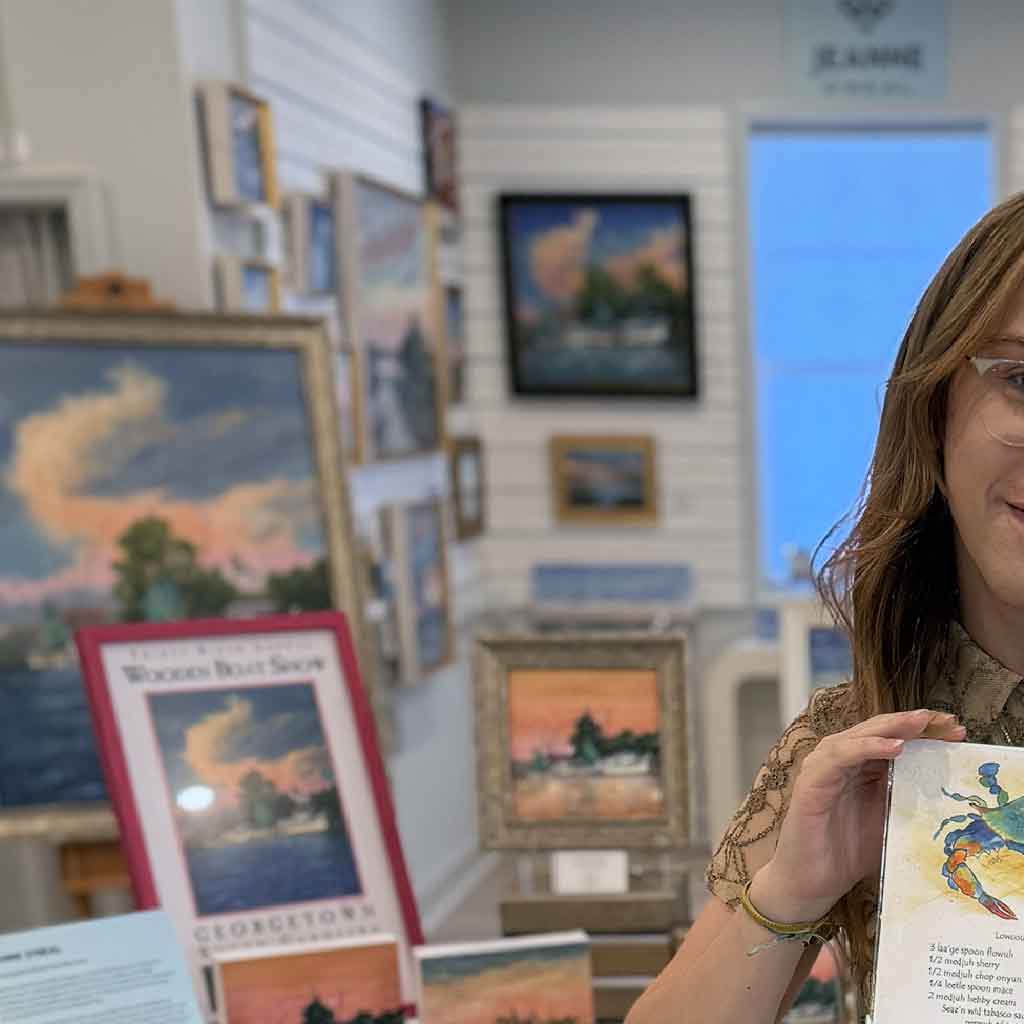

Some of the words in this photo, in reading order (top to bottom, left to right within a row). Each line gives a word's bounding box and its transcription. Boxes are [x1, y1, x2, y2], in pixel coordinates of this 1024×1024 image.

[960, 946, 984, 957] spoon
[928, 955, 942, 963] 1/2
[976, 959, 1000, 970] sherry
[928, 966, 941, 975] 1/2
[975, 970, 994, 982] chop
[967, 984, 991, 994] spoon
[992, 998, 1017, 1006] cream
[983, 1008, 1012, 1018] tabasco
